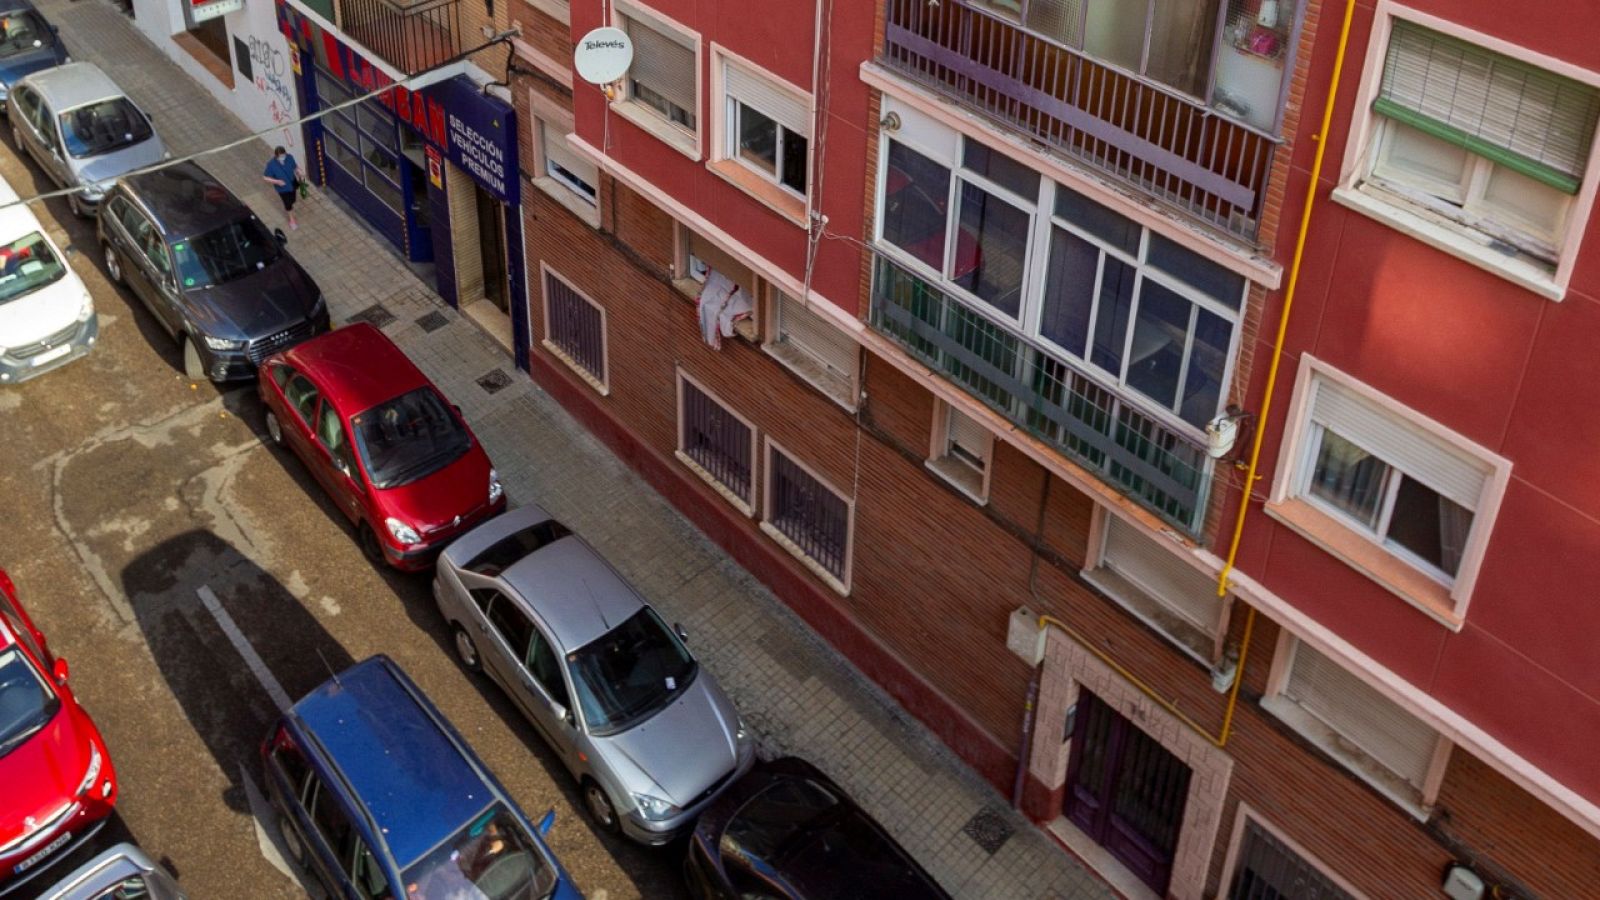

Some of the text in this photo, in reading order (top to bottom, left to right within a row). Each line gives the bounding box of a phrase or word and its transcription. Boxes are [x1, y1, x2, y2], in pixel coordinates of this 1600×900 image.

[584, 40, 625, 51] Televés
[449, 113, 503, 163] SELECCIÓN
[450, 128, 504, 179] VEHÍCULOS
[461, 152, 506, 196] PREMIUM
